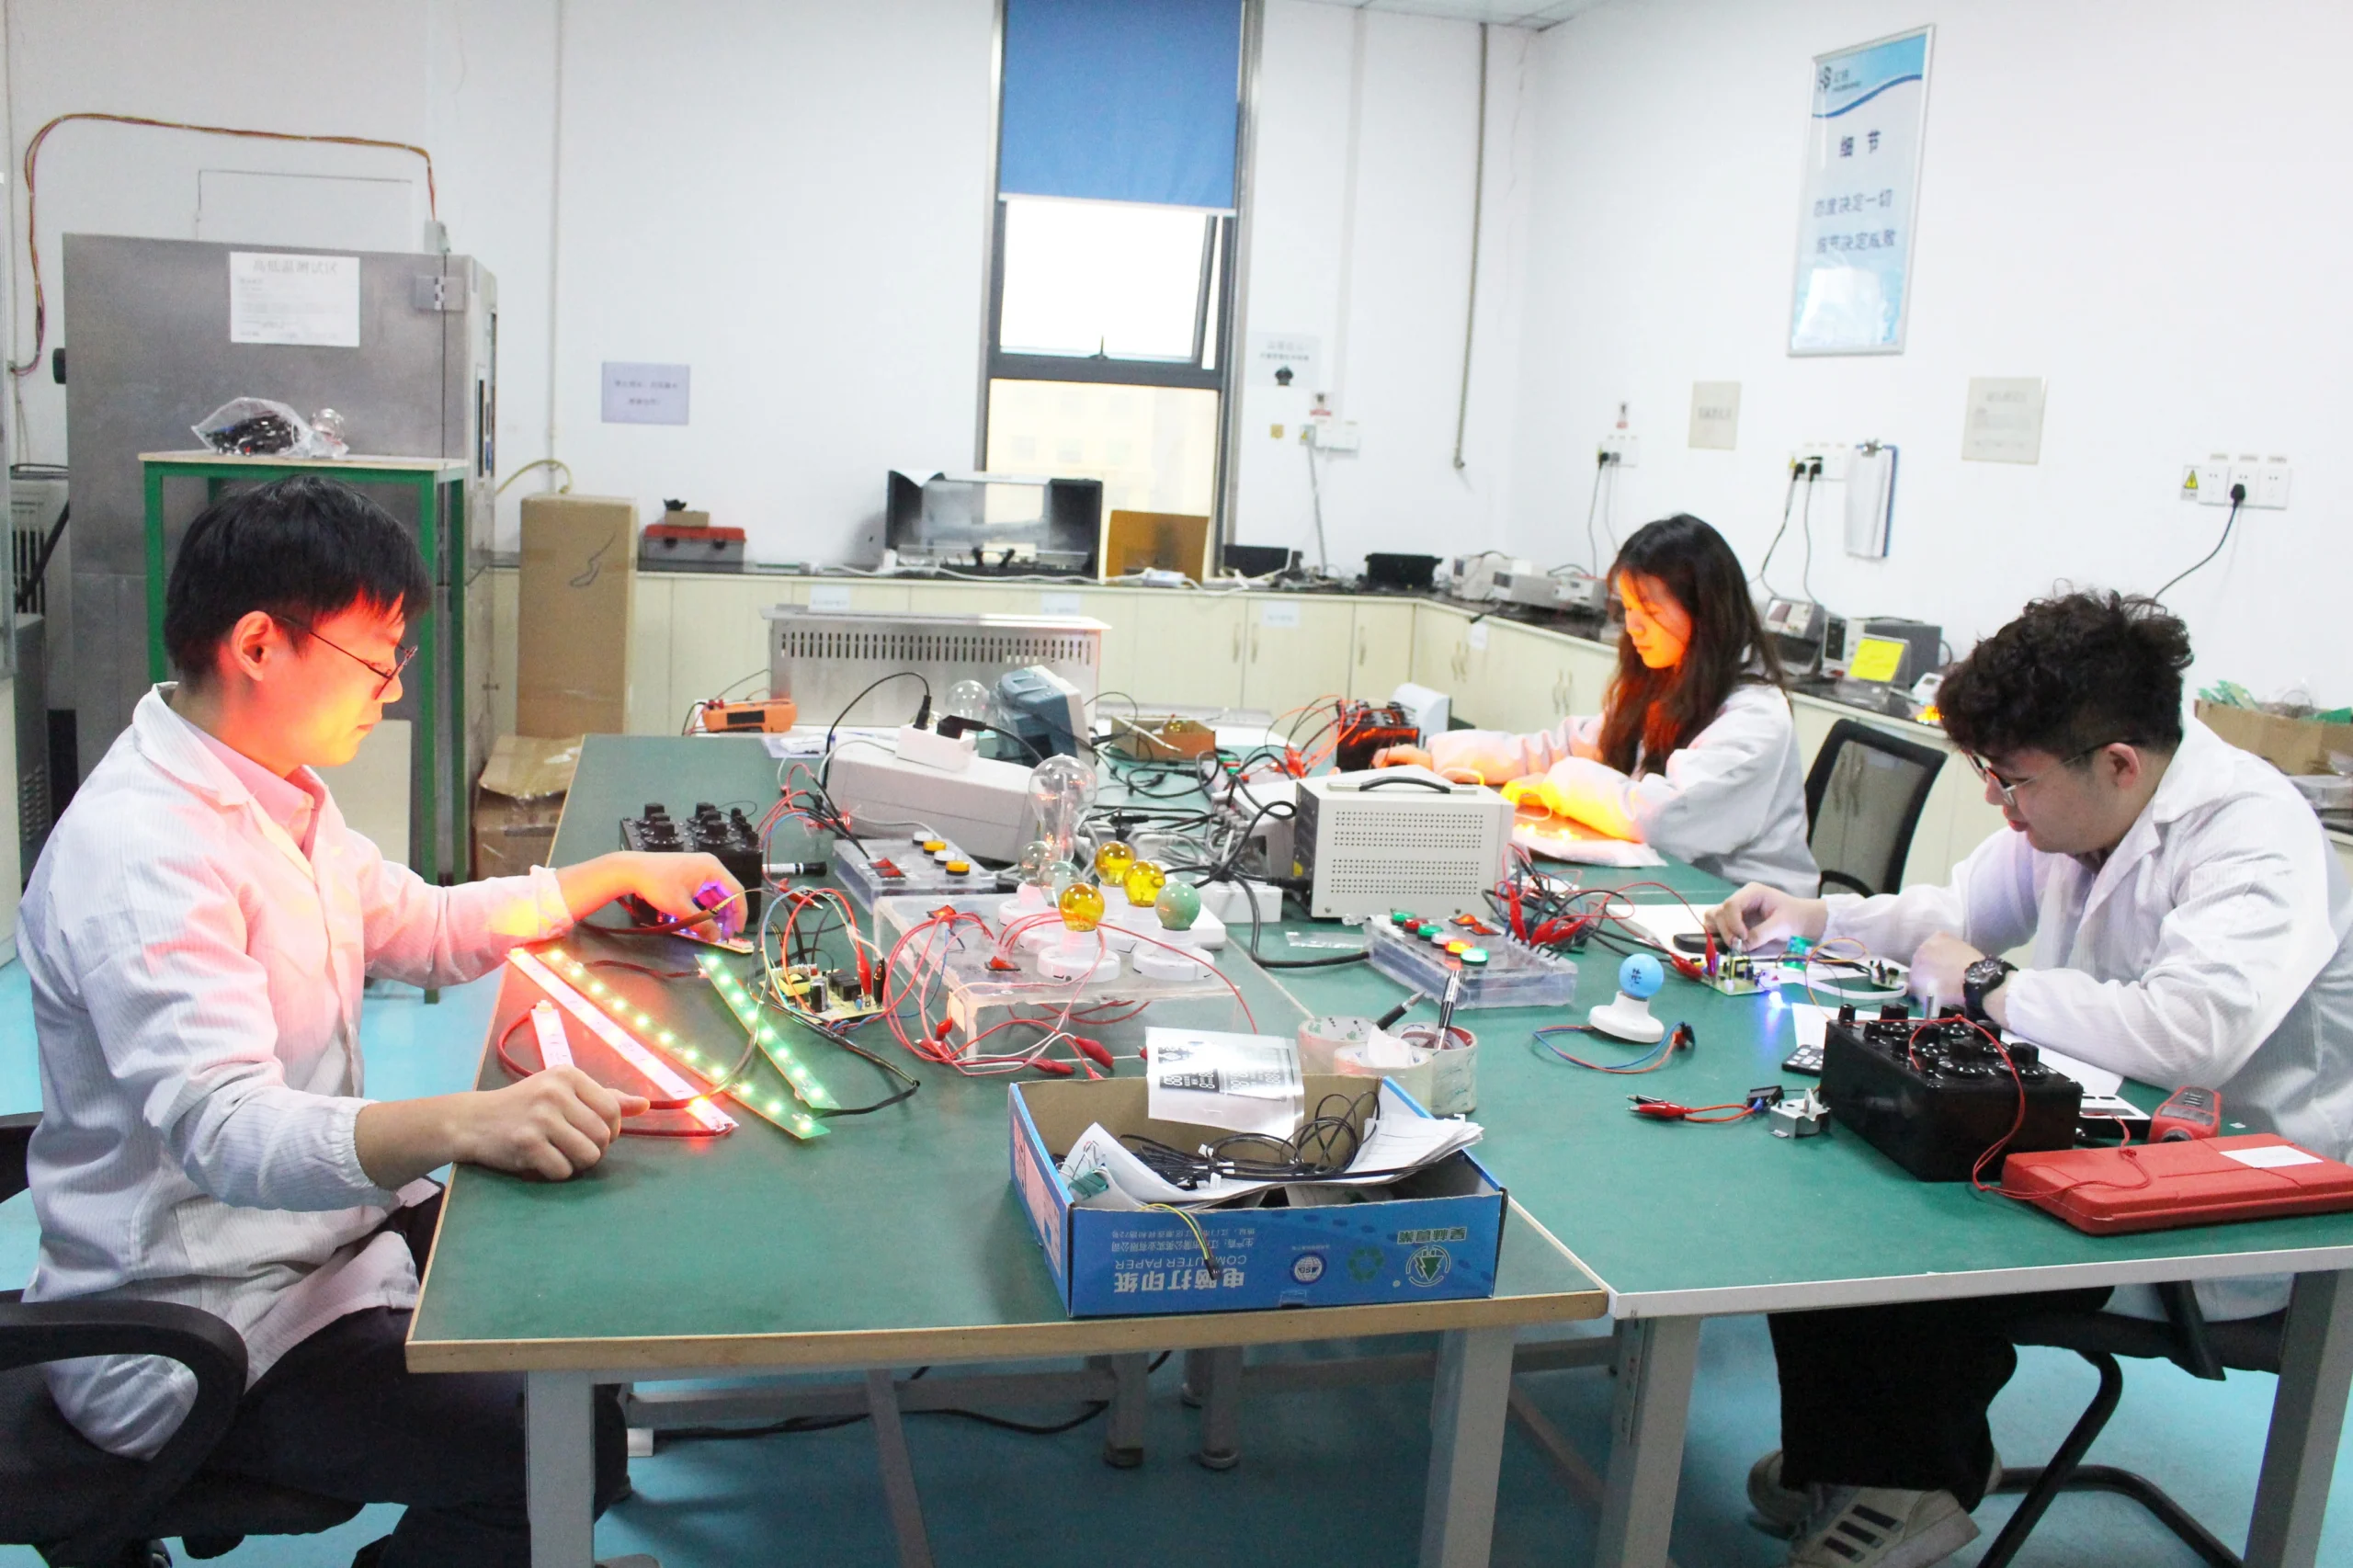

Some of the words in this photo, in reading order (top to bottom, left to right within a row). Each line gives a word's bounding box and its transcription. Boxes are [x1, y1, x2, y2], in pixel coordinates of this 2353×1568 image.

[1813, 188, 1893, 217] 态度决定一切
[1114, 1258, 1163, 1270] PAPER
[1166, 1255, 1247, 1269] COMUTER
[1114, 1267, 1245, 1293] 电脑打印纸
